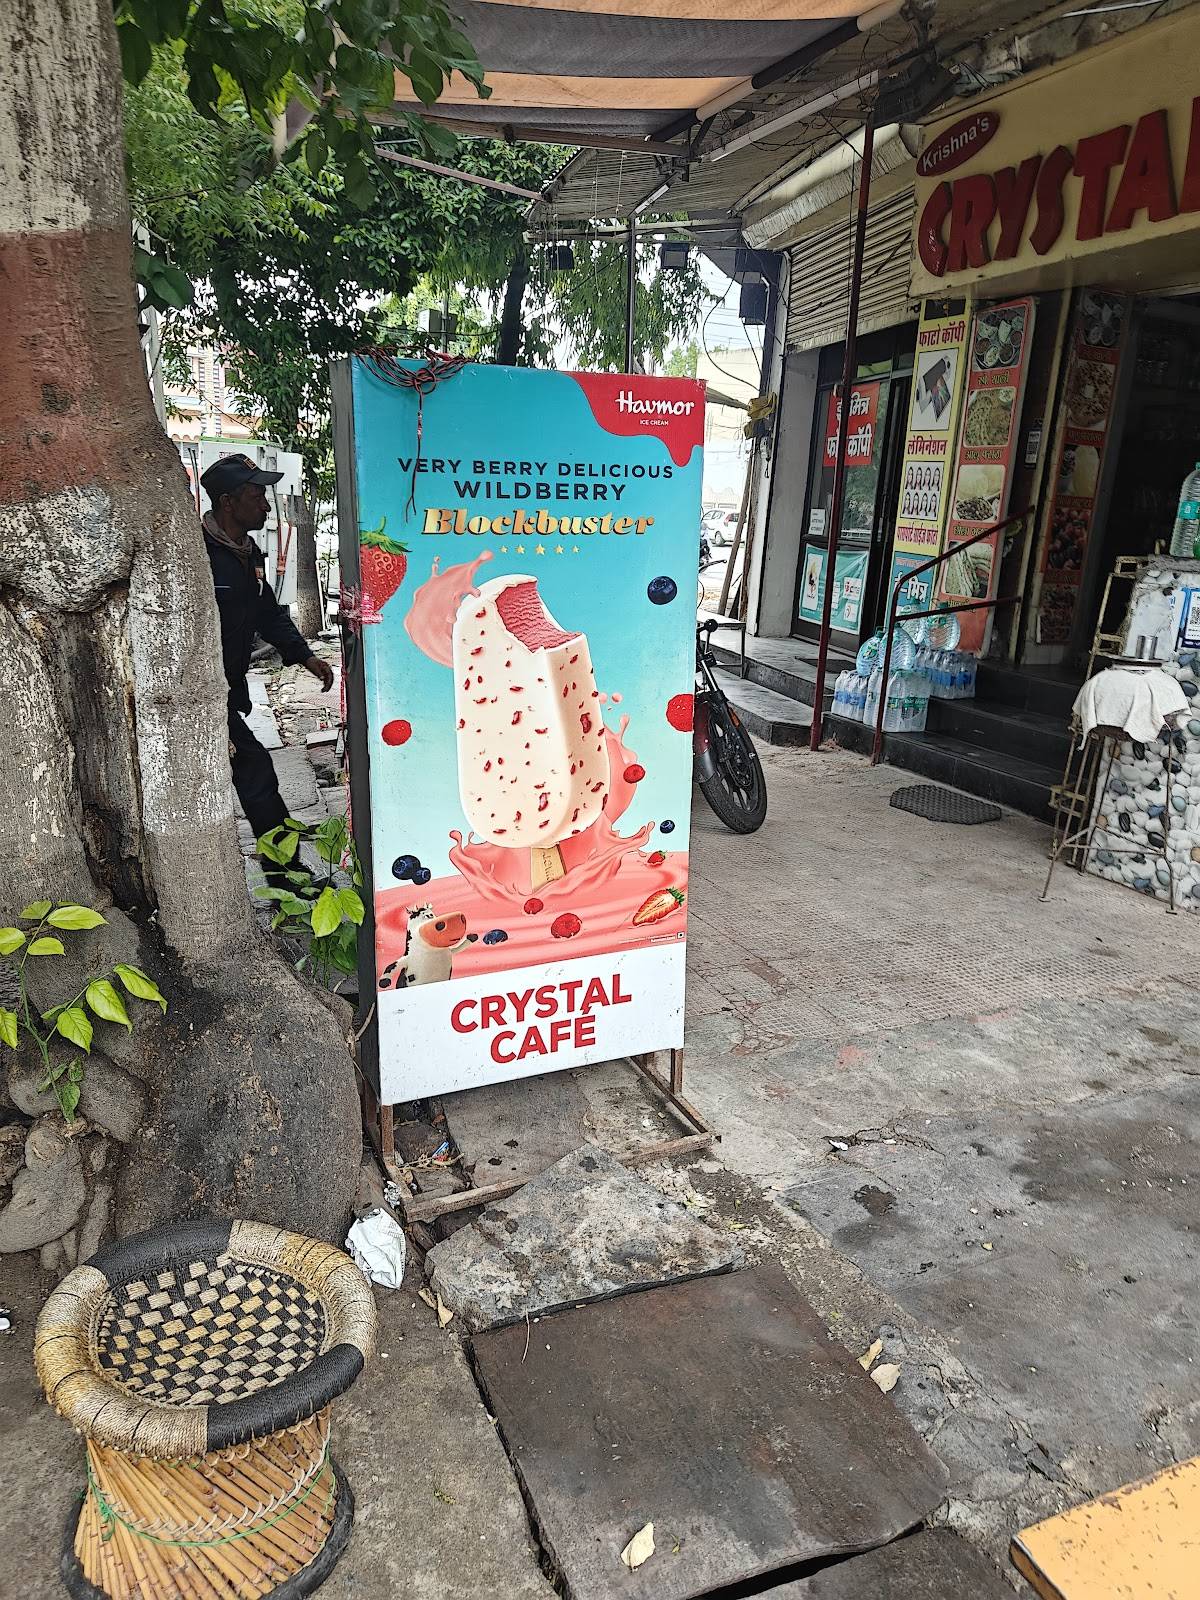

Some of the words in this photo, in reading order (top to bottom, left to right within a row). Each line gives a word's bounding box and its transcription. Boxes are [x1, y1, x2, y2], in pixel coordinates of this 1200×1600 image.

[922, 116, 990, 173] Krishna's
[615, 390, 695, 416] Havmor
[398, 458, 462, 473] VERY
[473, 460, 548, 476] BERRY
[558, 463, 673, 479] DELICIOUS
[453, 480, 627, 501] WILDBERRY
[421, 508, 655, 535] Blockbuster
[450, 973, 633, 1034] CRYSTAL
[490, 1004, 597, 1064] CAFÉ
